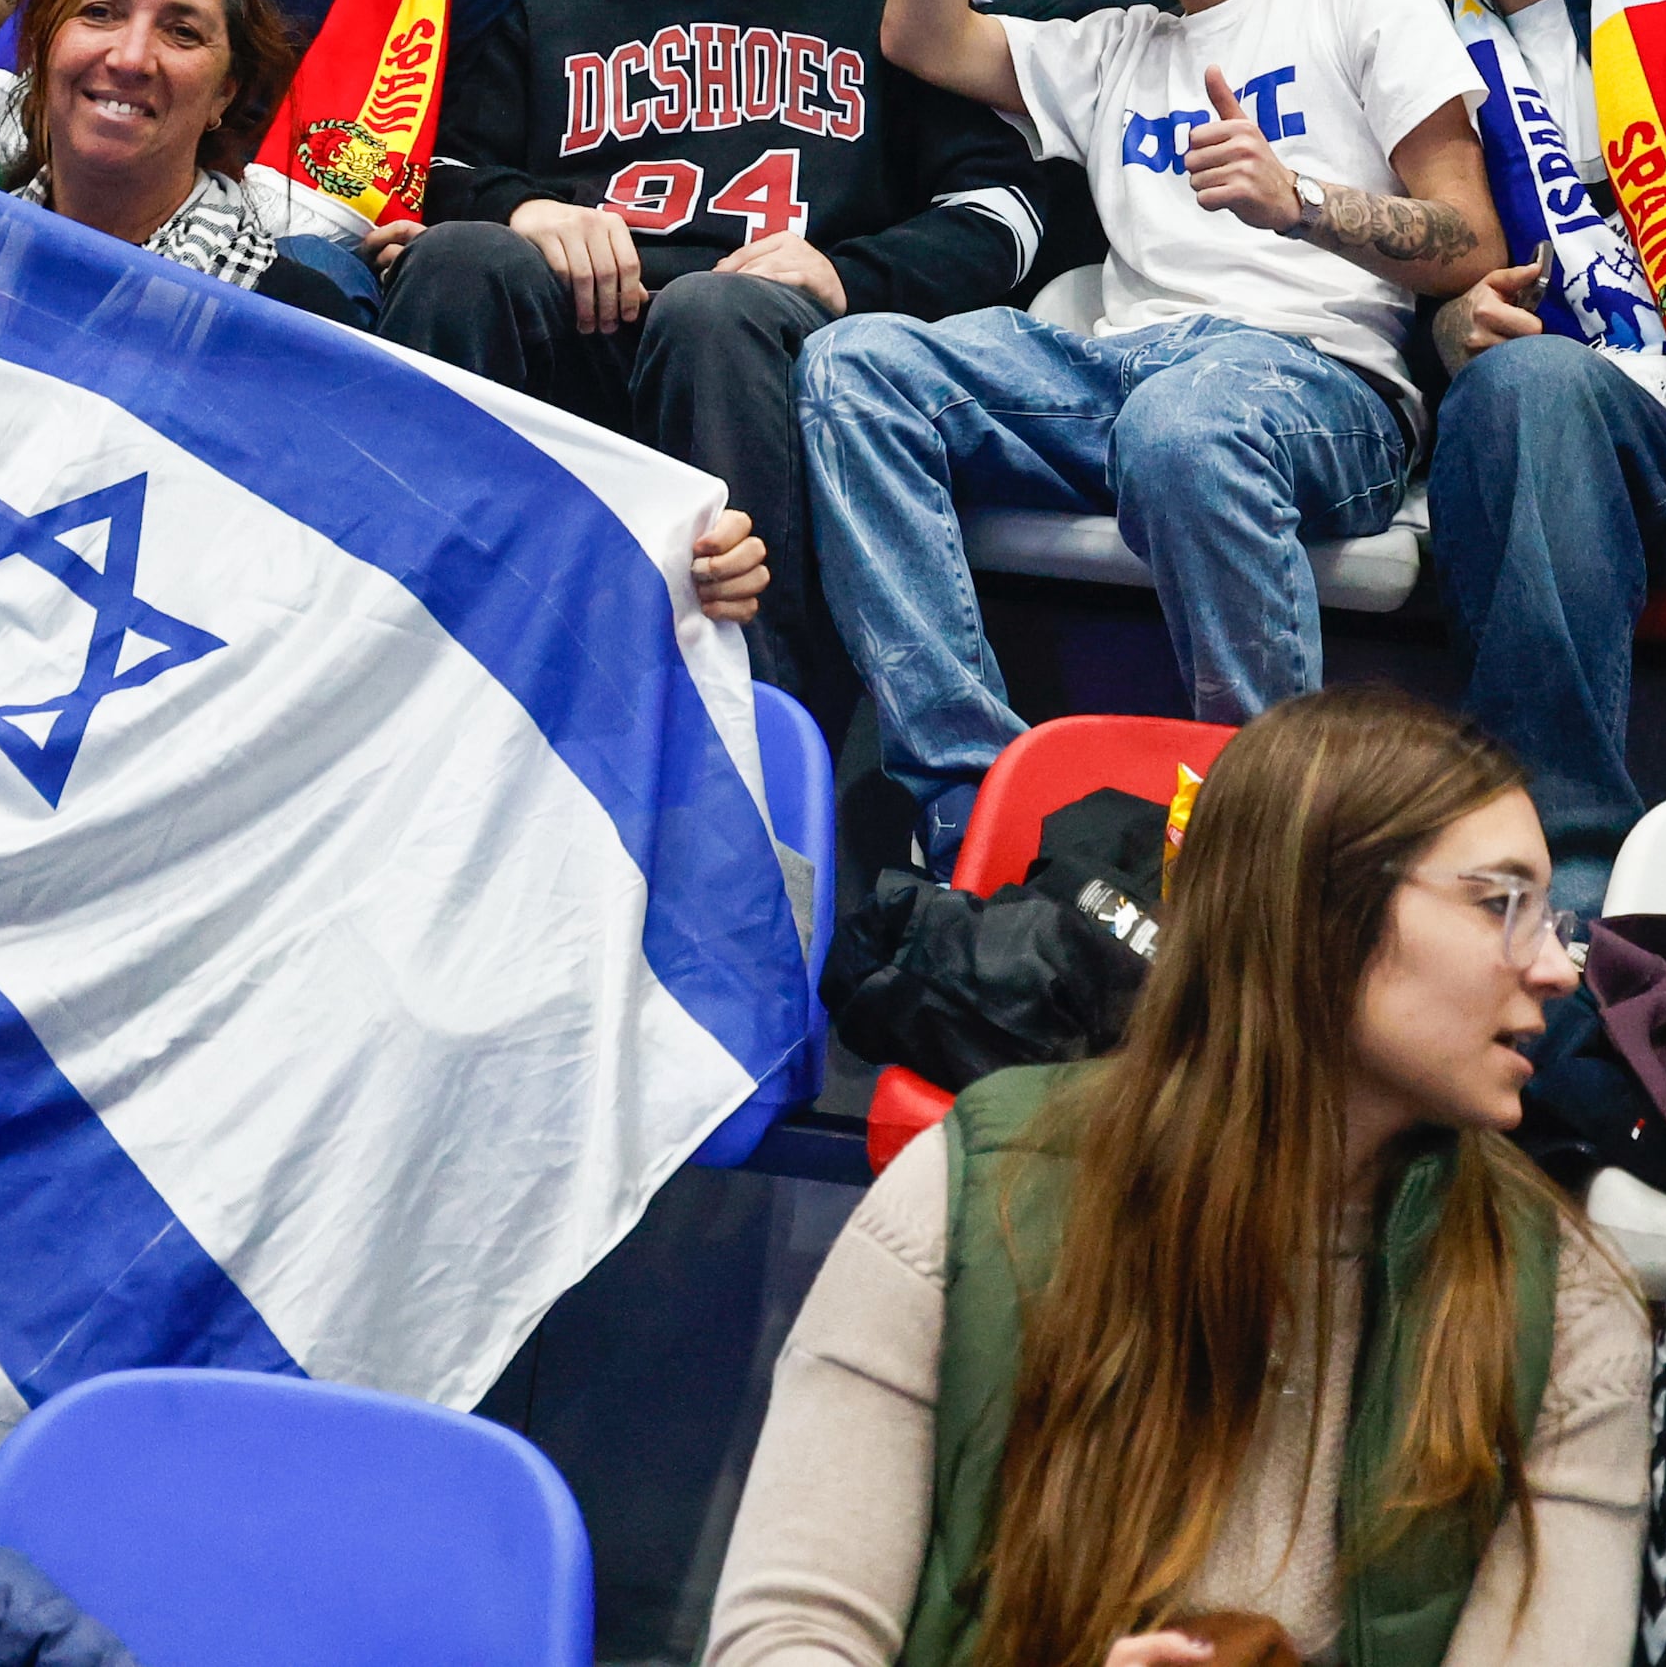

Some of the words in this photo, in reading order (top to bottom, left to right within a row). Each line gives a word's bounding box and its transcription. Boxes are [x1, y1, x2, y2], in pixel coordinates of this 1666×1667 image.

[362, 17, 436, 134] SPAIN
[558, 22, 866, 159] DCSHOES
[595, 147, 810, 247] 94
